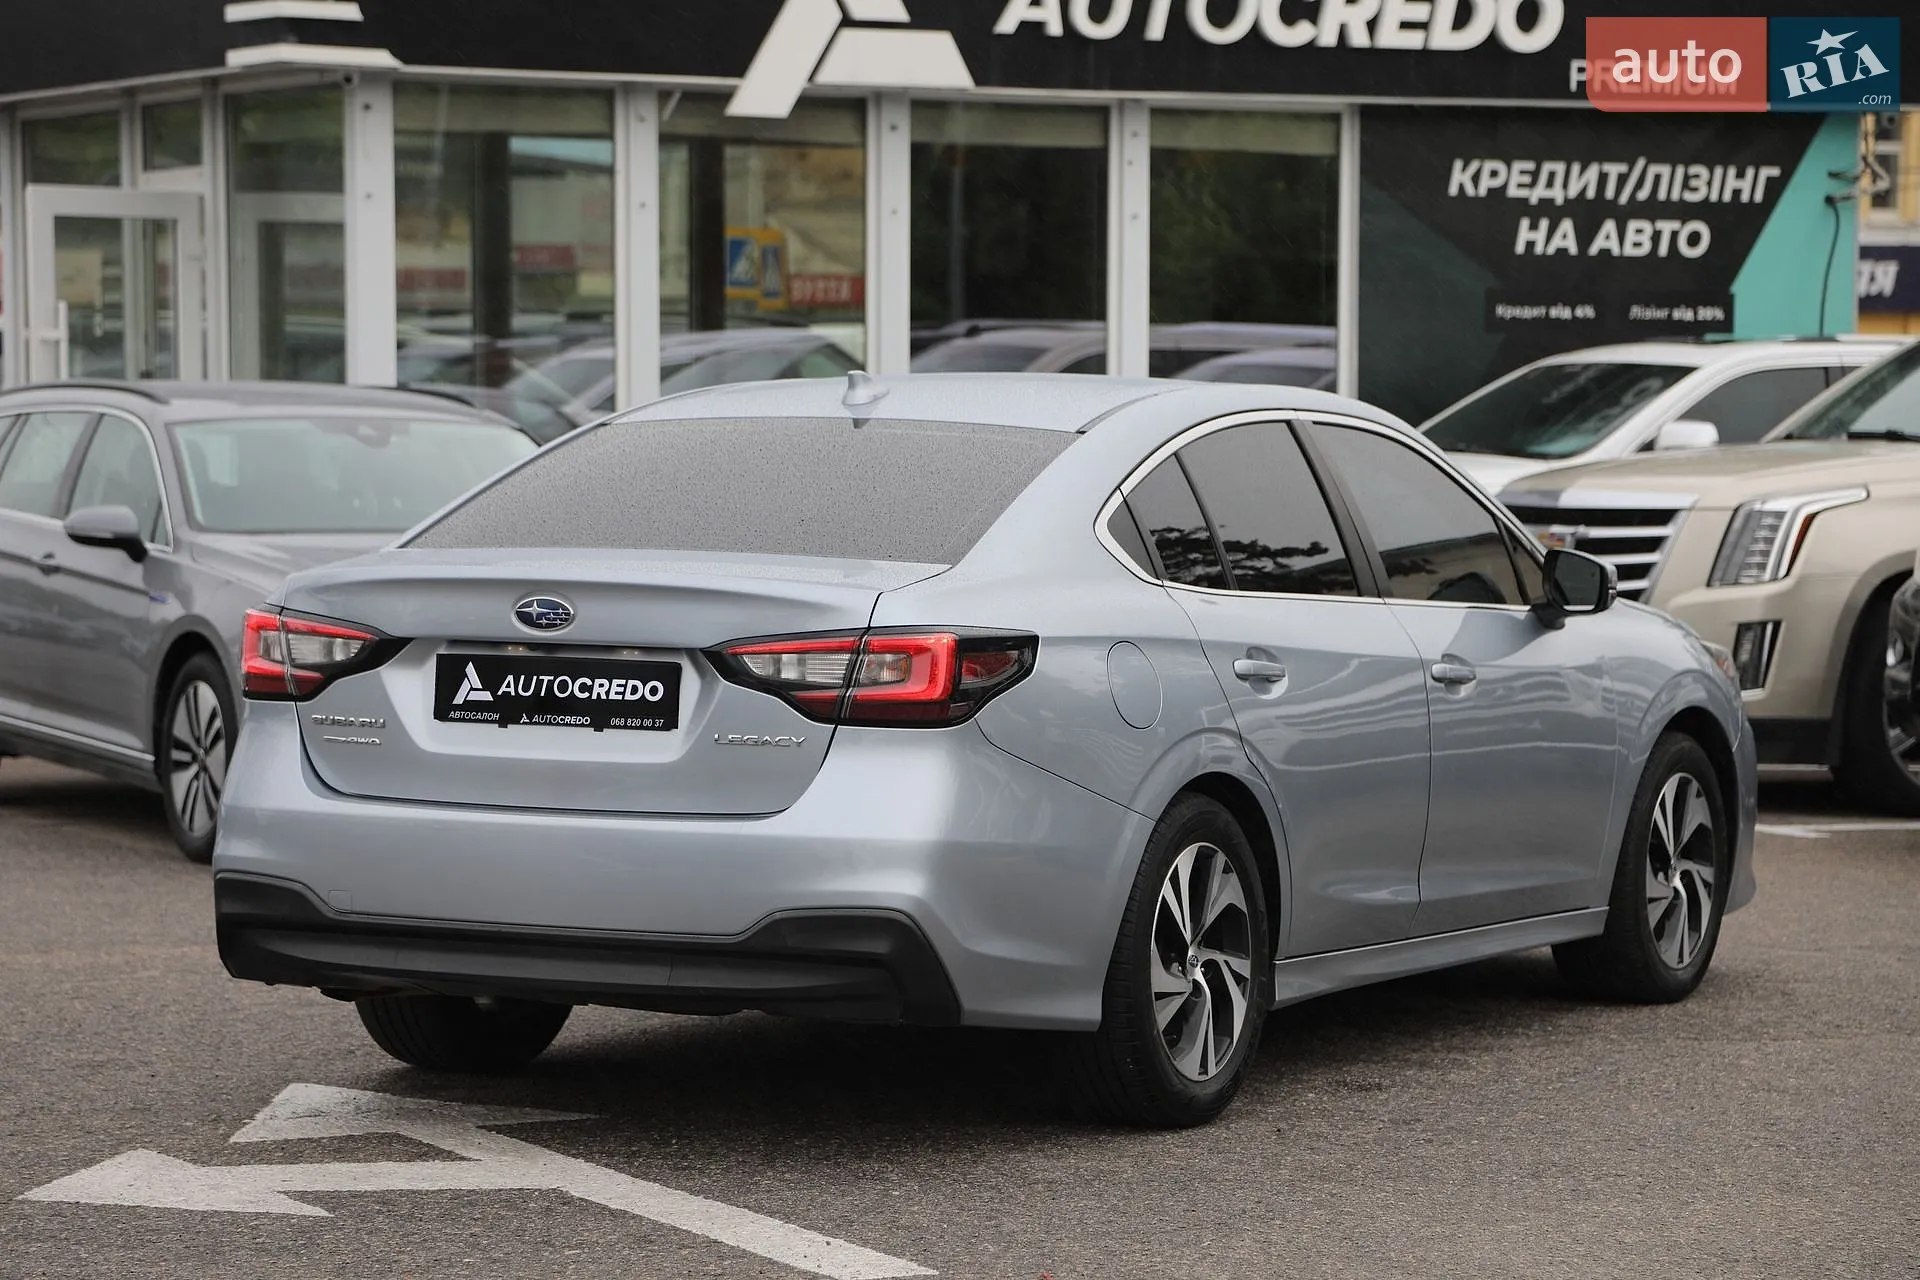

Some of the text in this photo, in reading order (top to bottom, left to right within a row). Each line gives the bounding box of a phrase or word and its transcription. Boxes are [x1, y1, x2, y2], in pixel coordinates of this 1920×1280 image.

[1447, 156, 1782, 205] КРЕДИТ/ЛІЗІНГ
[1514, 216, 1712, 259] НА АВТО
[496, 674, 664, 702] AUTOCREDO
[311, 714, 386, 729] SUBARU
[448, 711, 500, 721] АВТОСАЛОН
[532, 714, 591, 725] AUTOCREDO
[610, 717, 664, 728] 068 820 00 37
[714, 733, 807, 748] LEGACY
